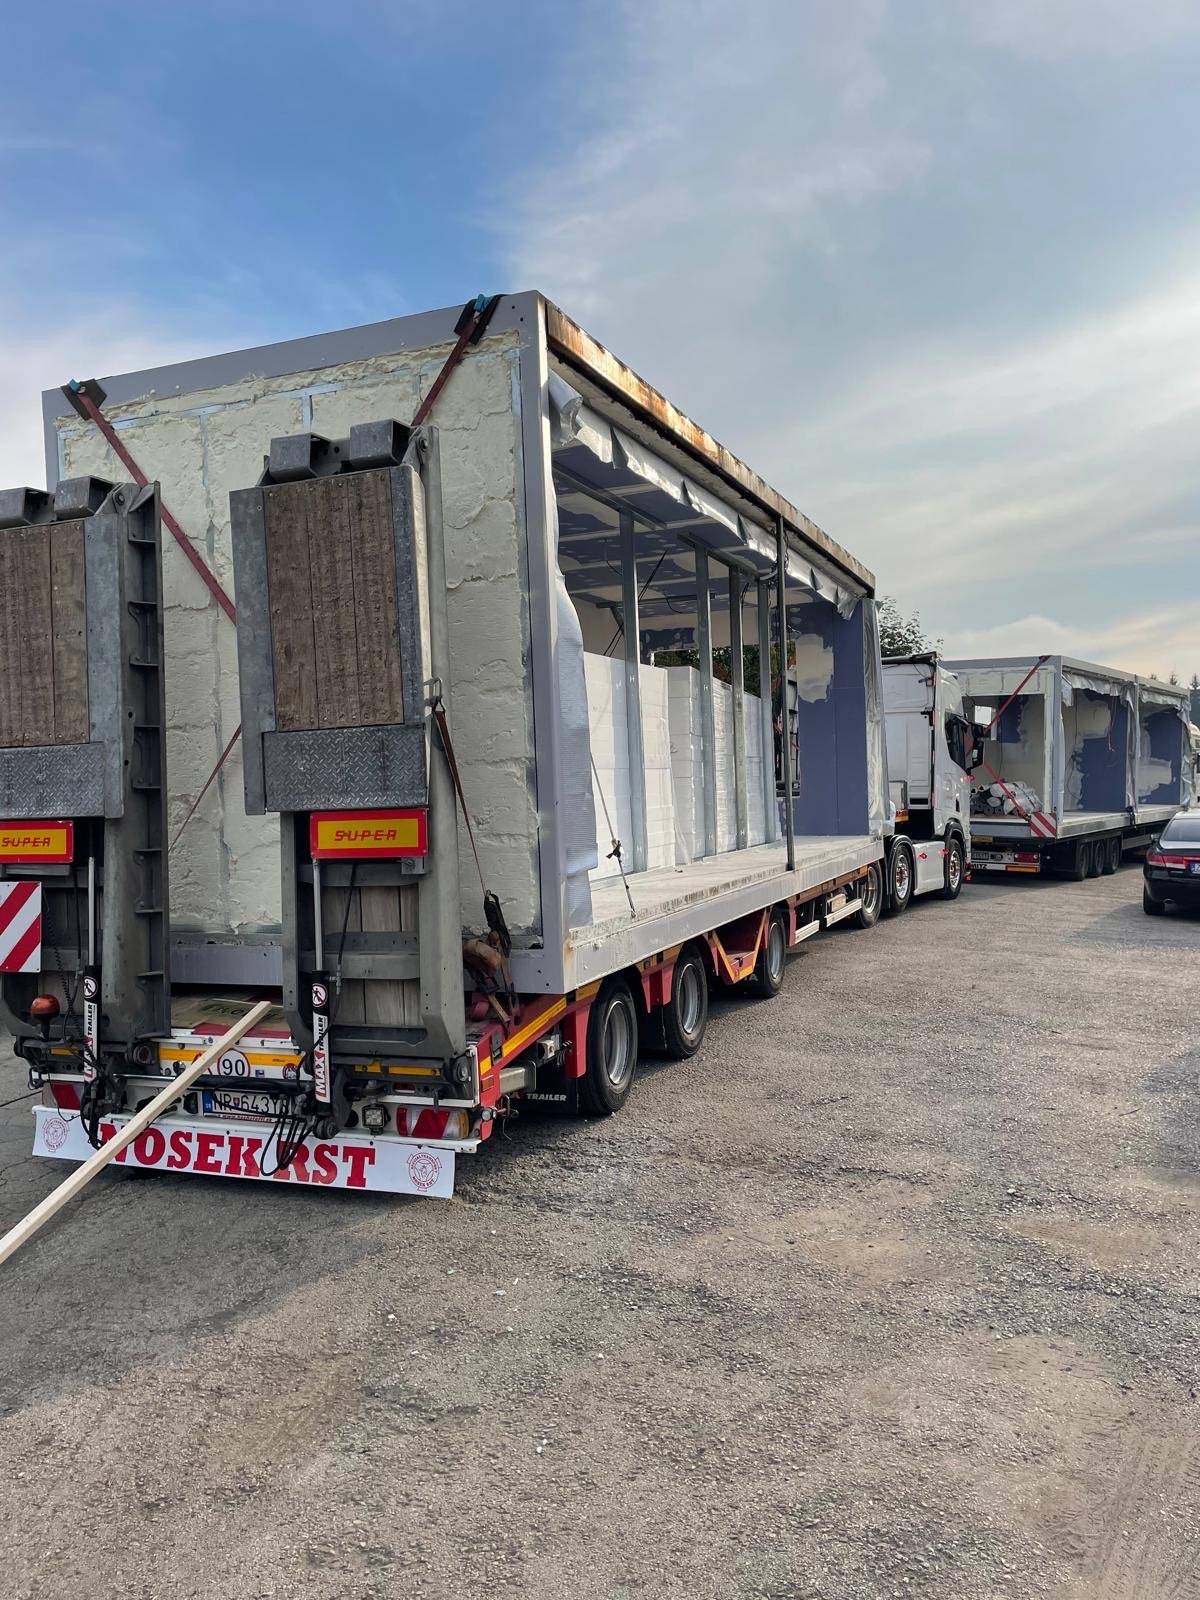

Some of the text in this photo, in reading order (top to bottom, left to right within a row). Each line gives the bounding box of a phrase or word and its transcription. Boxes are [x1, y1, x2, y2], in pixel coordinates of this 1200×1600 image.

[1, 836, 51, 848] SUPER
[334, 829, 398, 842] SUPER
[221, 1058, 246, 1076] 90
[314, 1053, 327, 1097] MAX
[213, 1092, 232, 1112] NR
[526, 1093, 567, 1102] TRAILER
